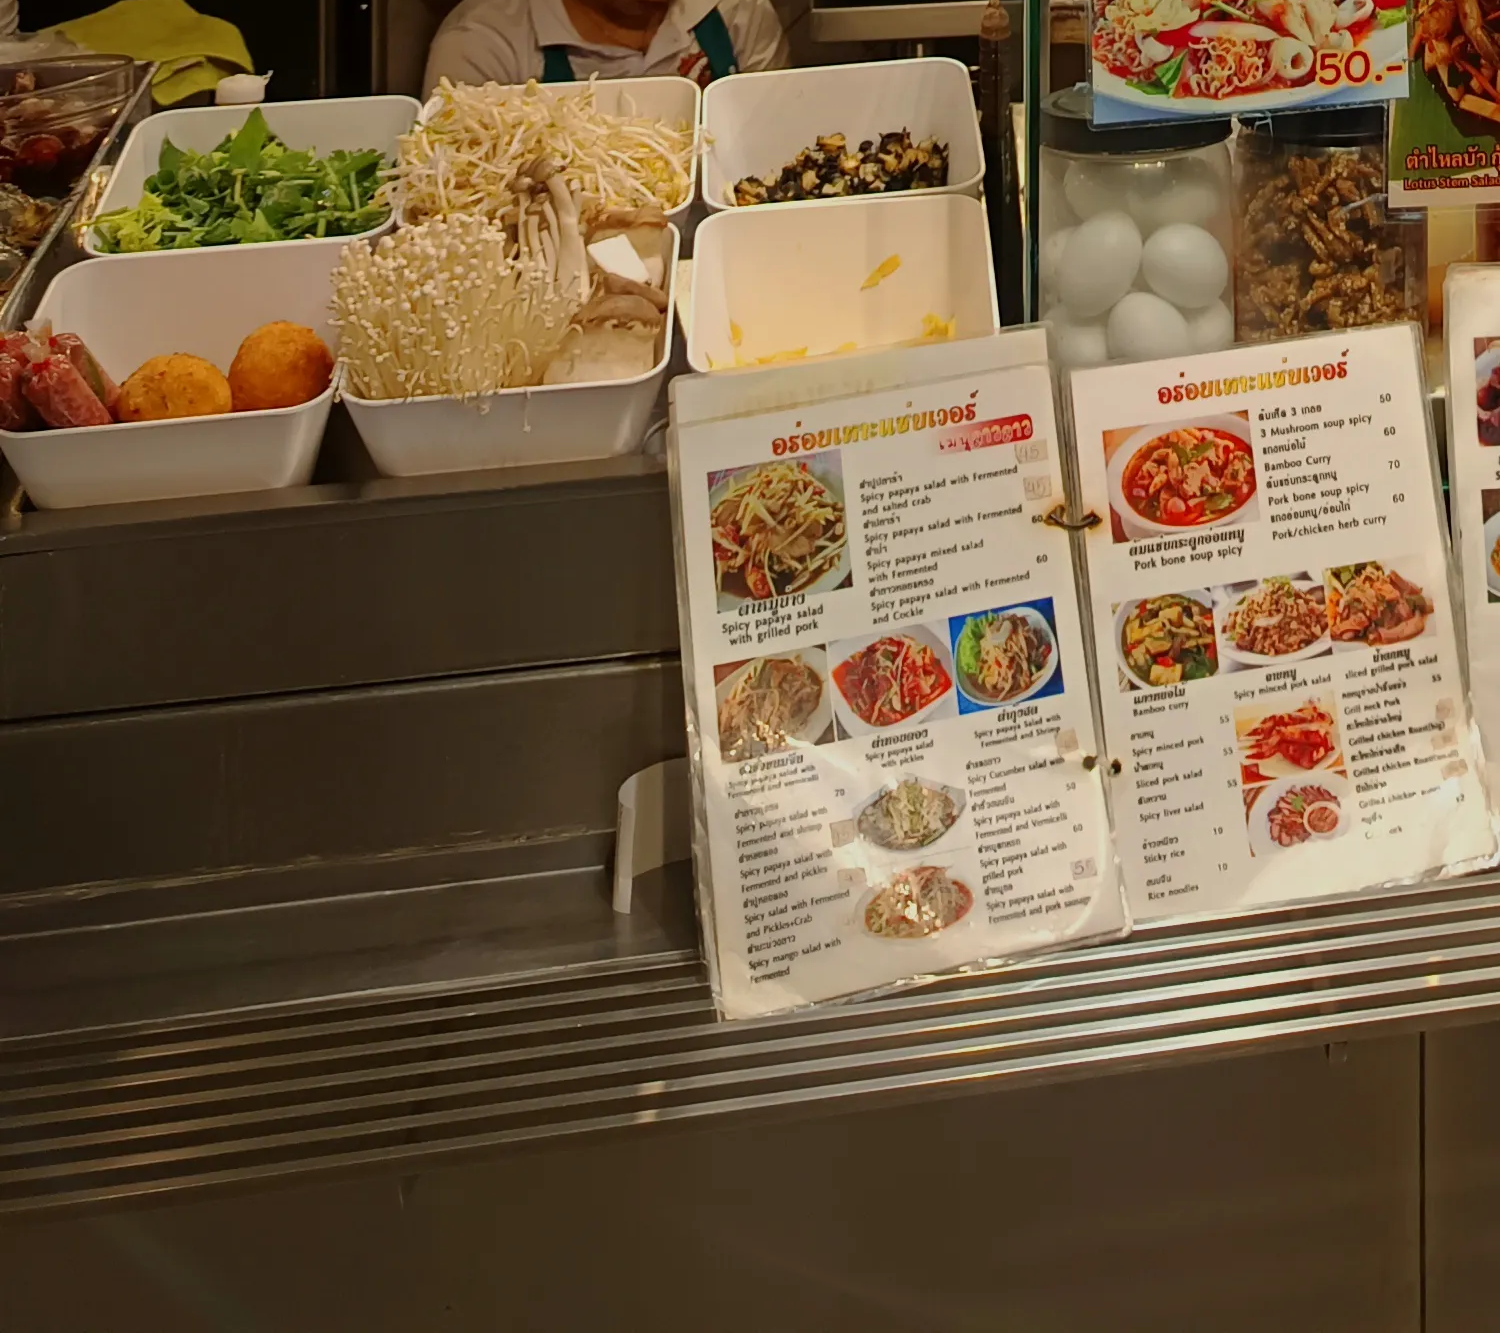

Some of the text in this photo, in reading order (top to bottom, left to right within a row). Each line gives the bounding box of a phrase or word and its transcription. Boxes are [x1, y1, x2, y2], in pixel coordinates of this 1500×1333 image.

[1314, 49, 1405, 86] 50.-
[1405, 145, 1487, 170] ตำไหลบัว
[1404, 178, 1437, 190] Lotus
[1439, 176, 1470, 188] Stem
[1260, 414, 1373, 438] 3 Mushroom soup spicy
[1383, 426, 1396, 437] 60
[1264, 454, 1332, 472] Bamboo Curry
[1388, 460, 1401, 470] 70
[860, 464, 1018, 504] Spicy papaya salad with Fermented
[1268, 482, 1371, 507] Pork bone soup spicy
[1392, 493, 1405, 504] 60
[1031, 514, 1043, 524] 60
[1272, 514, 1387, 541] Pork/chicken herb curry
[722, 604, 824, 636] Spicy papaya salad
[729, 619, 818, 646] with grilled pork
